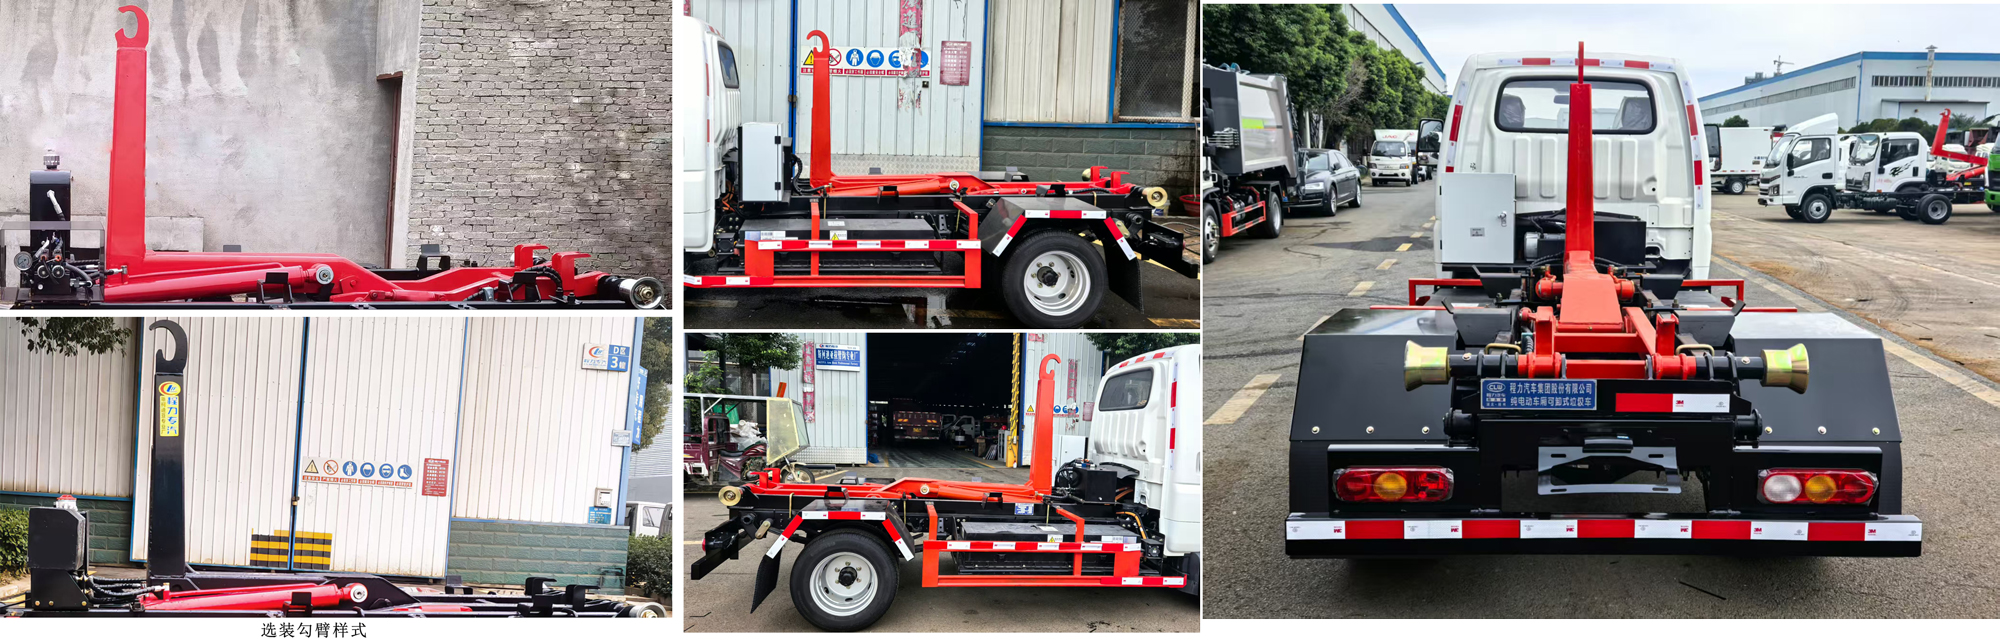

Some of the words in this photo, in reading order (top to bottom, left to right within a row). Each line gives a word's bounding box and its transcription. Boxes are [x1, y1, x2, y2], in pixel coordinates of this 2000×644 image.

[613, 347, 626, 355] D区
[1509, 382, 1592, 394] 程力汽车集团股份有限公司
[1510, 397, 1592, 406] 纯电动车厢可卸式垃圾车
[167, 396, 178, 435] 程力专汽
